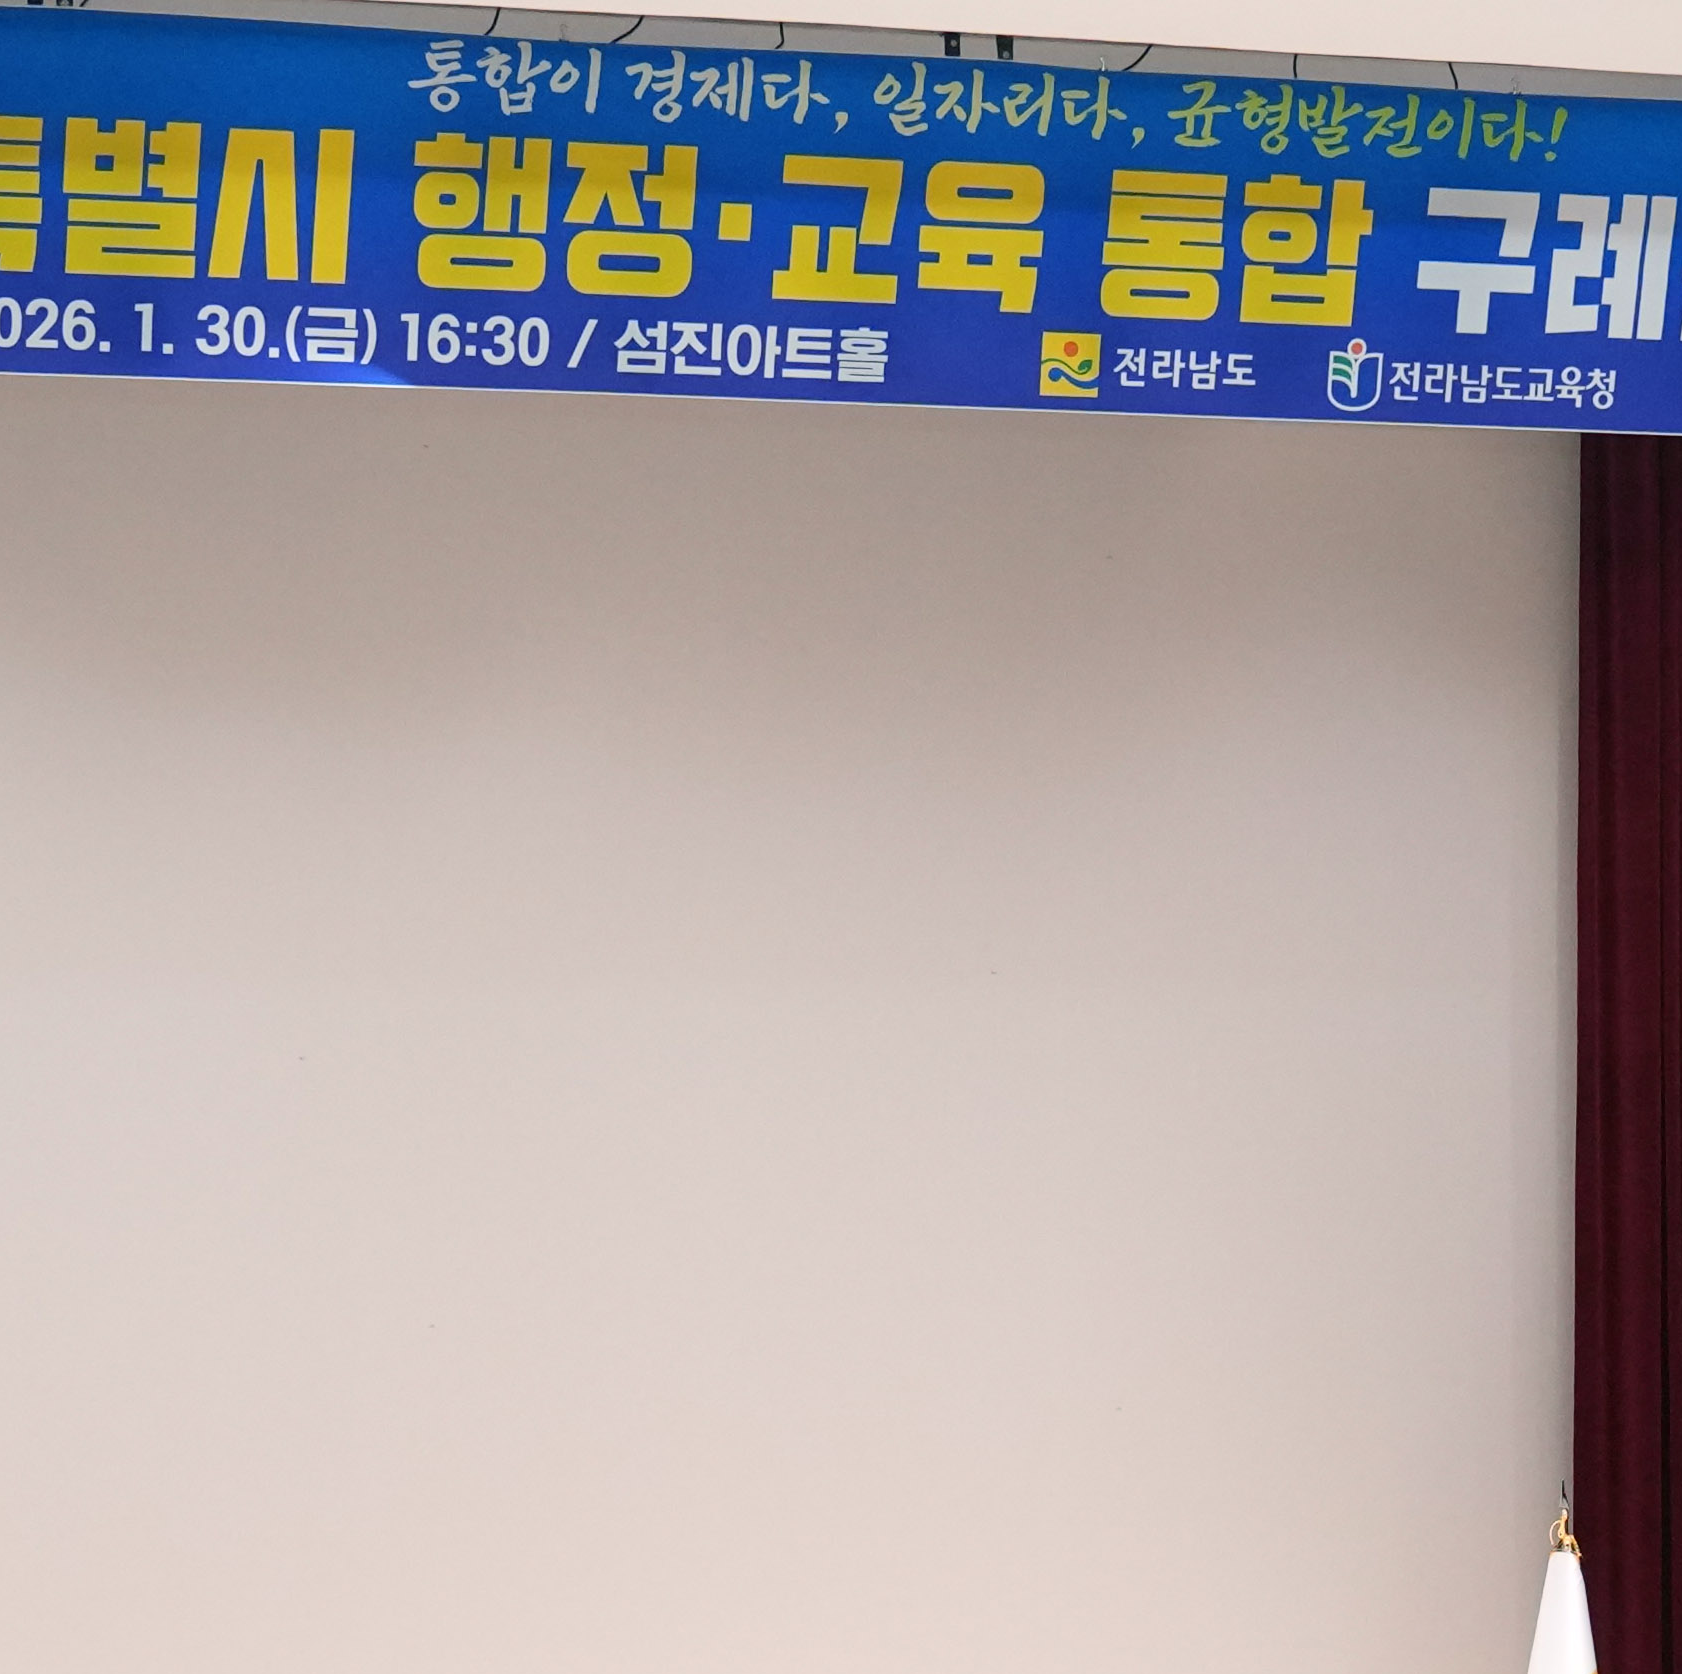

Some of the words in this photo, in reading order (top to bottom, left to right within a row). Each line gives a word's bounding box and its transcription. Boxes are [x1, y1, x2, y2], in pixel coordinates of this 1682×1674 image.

[408, 40, 602, 115] 통합이
[625, 51, 848, 134] 경제다,
[873, 62, 1146, 150] 일자리다,
[1167, 78, 1569, 162] 균형발전이다!
[413, 131, 1047, 313] 행정·교육
[1099, 168, 1374, 328] 통합
[134, 303, 175, 356] 1.
[195, 305, 378, 366] 30.(금)
[400, 313, 550, 368] 16:30
[614, 319, 889, 383] 섬진아트홀
[1114, 348, 1257, 389] 전라남도
[1389, 362, 1617, 411] 전라남도교육청
